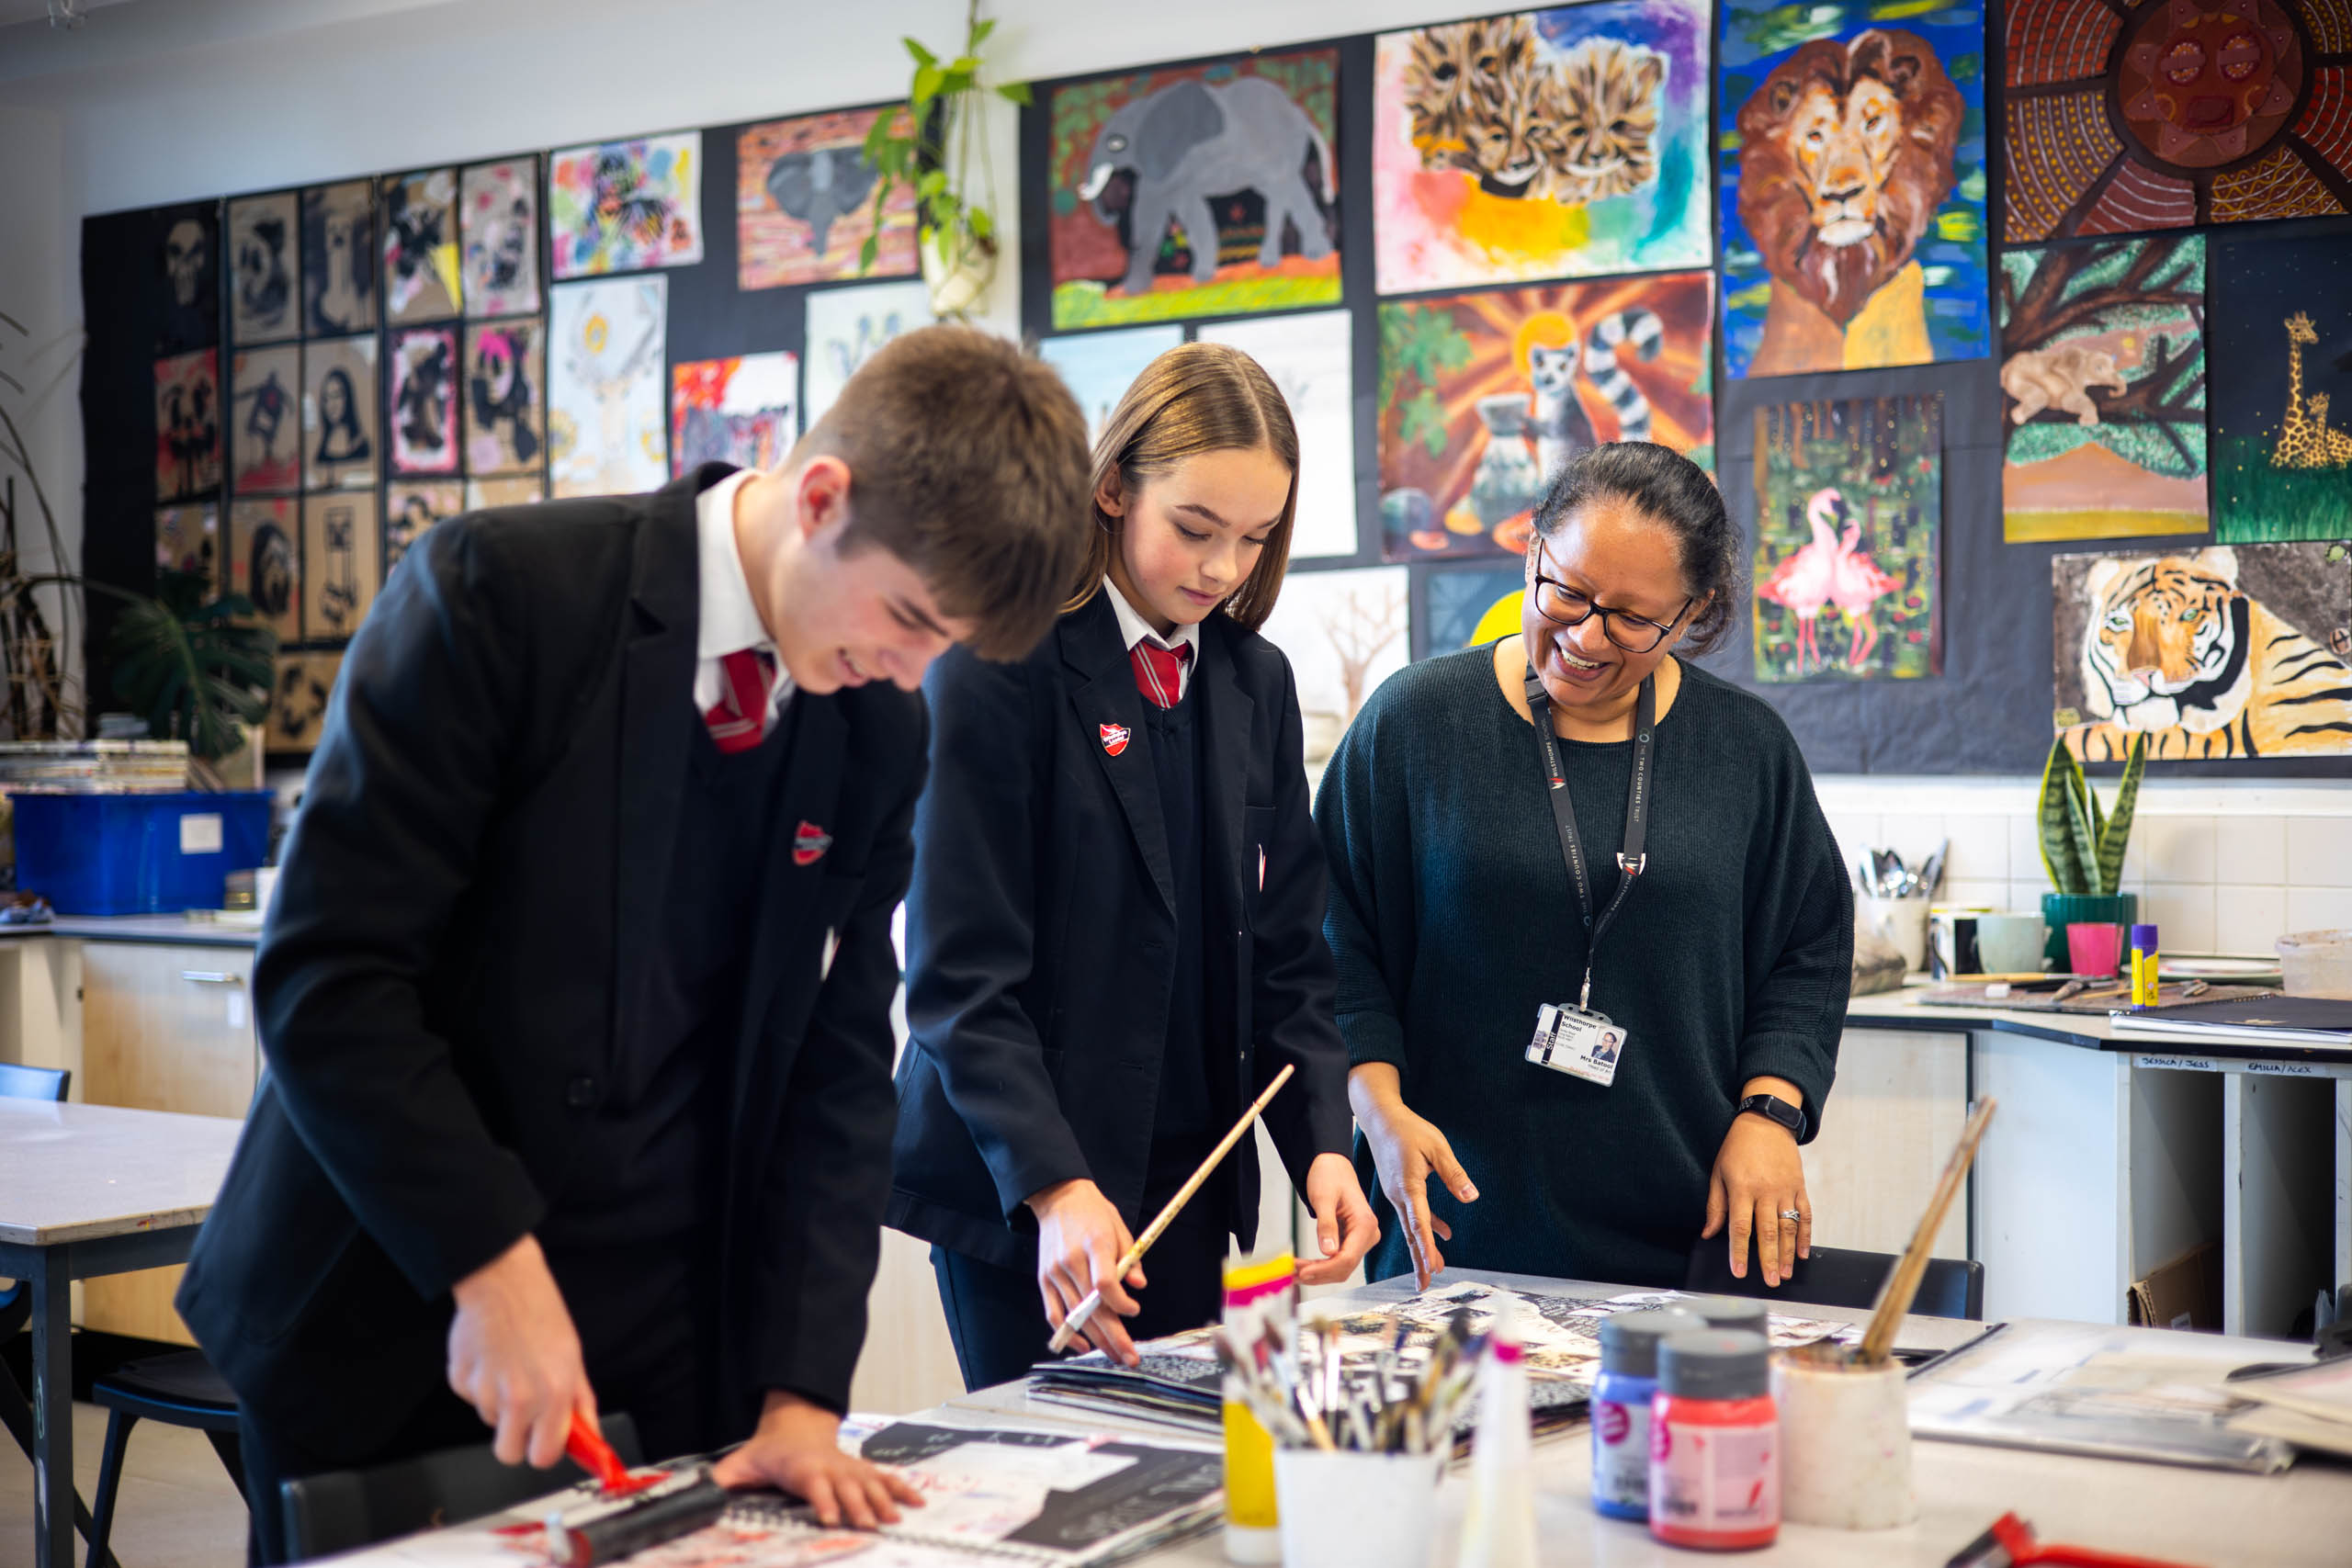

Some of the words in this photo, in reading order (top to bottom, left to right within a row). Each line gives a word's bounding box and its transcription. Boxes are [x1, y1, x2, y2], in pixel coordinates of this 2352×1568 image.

[1545, 741, 1558, 777] WILSTHORPE
[1634, 773, 1644, 805] COUNTIES
[1565, 825, 1573, 843] TRUST
[1569, 844, 1582, 881] COUNTIES
[1562, 1021, 1582, 1032] School
[1564, 1015, 1597, 1029] Wilsthorpe
[1546, 1032, 1556, 1050] Staff
[1580, 1055, 1591, 1063] Mrs
[2142, 1057, 2177, 1066] JESSICA
[2185, 1059, 2210, 1068] JESS
